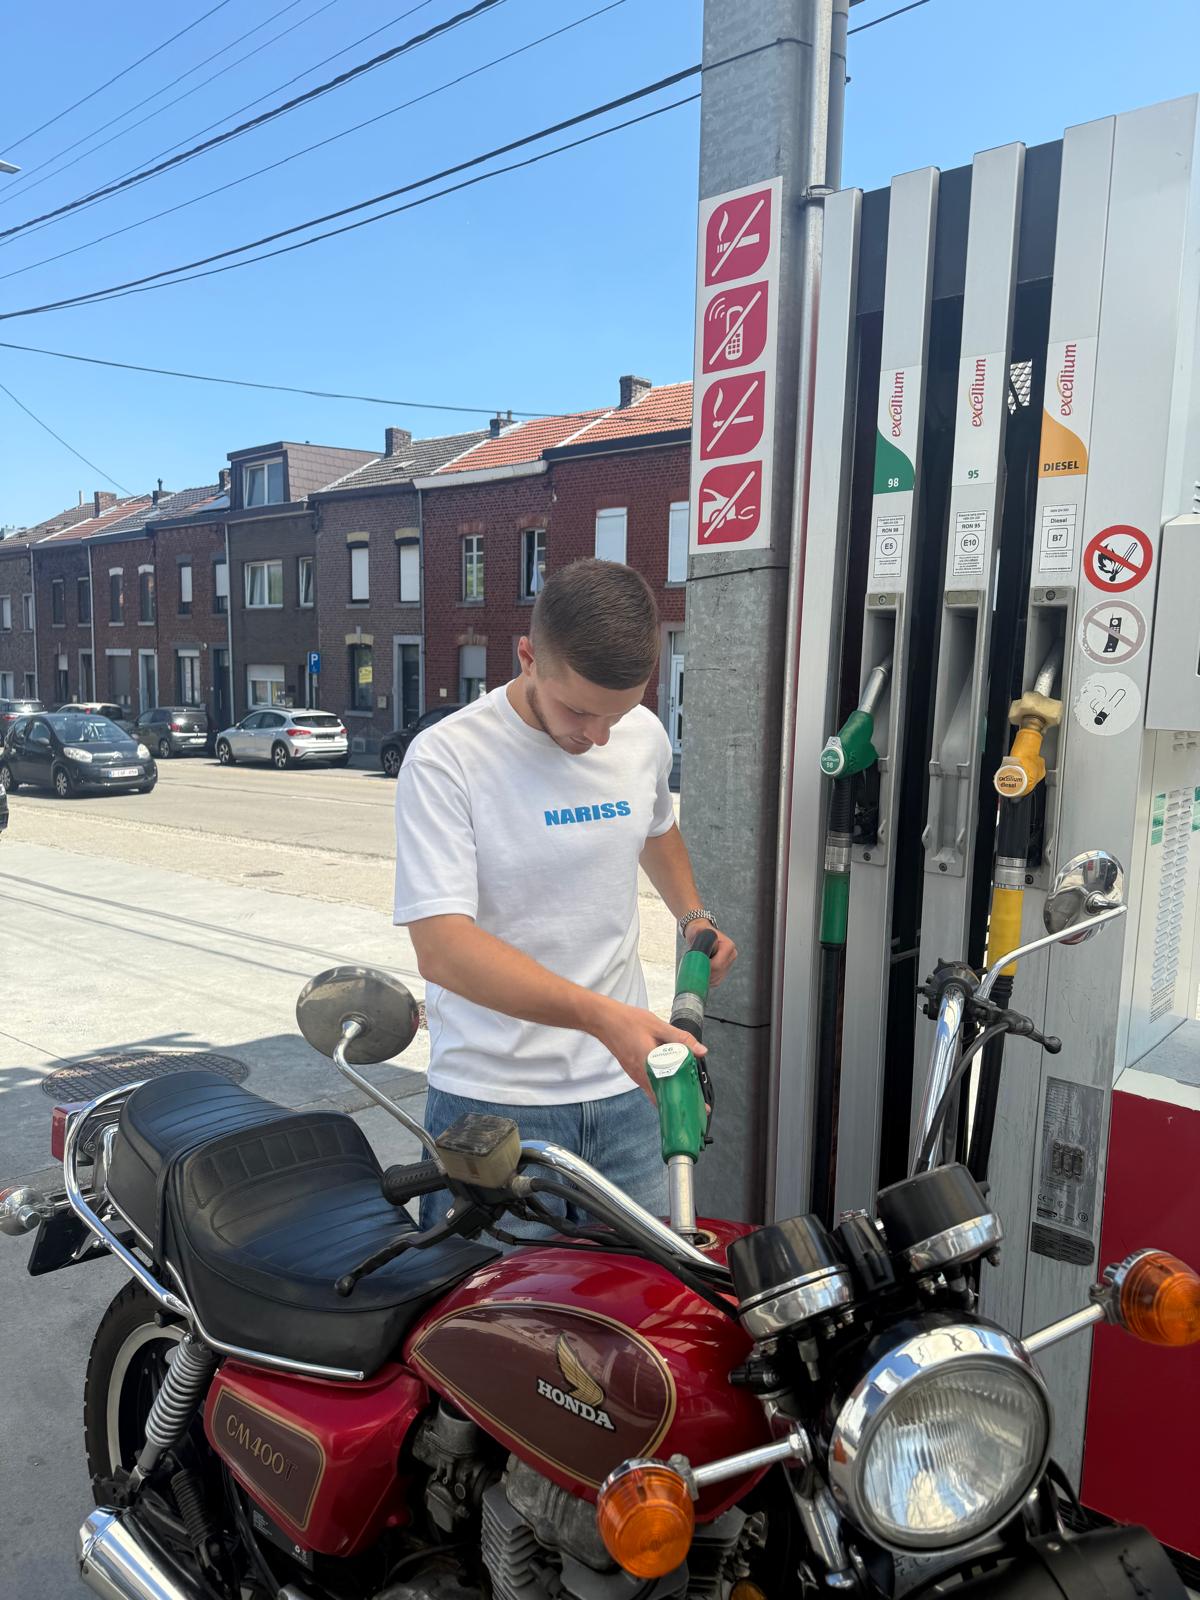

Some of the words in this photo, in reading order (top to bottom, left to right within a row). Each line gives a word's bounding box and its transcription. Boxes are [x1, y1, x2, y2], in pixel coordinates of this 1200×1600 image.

[1060, 343, 1077, 417] excellium
[971, 358, 987, 428] excellium
[891, 371, 905, 438] excellium
[1043, 460, 1080, 472] DIESEL
[967, 469, 980, 480] 95
[887, 477, 900, 488] 98
[963, 539, 977, 547] E10
[1052, 534, 1063, 542] B7
[884, 542, 894, 550] E5
[311, 653, 319, 666] P
[544, 800, 631, 826] NARISS
[537, 1378, 615, 1431] HONDA
[226, 1414, 299, 1482] CM400T
